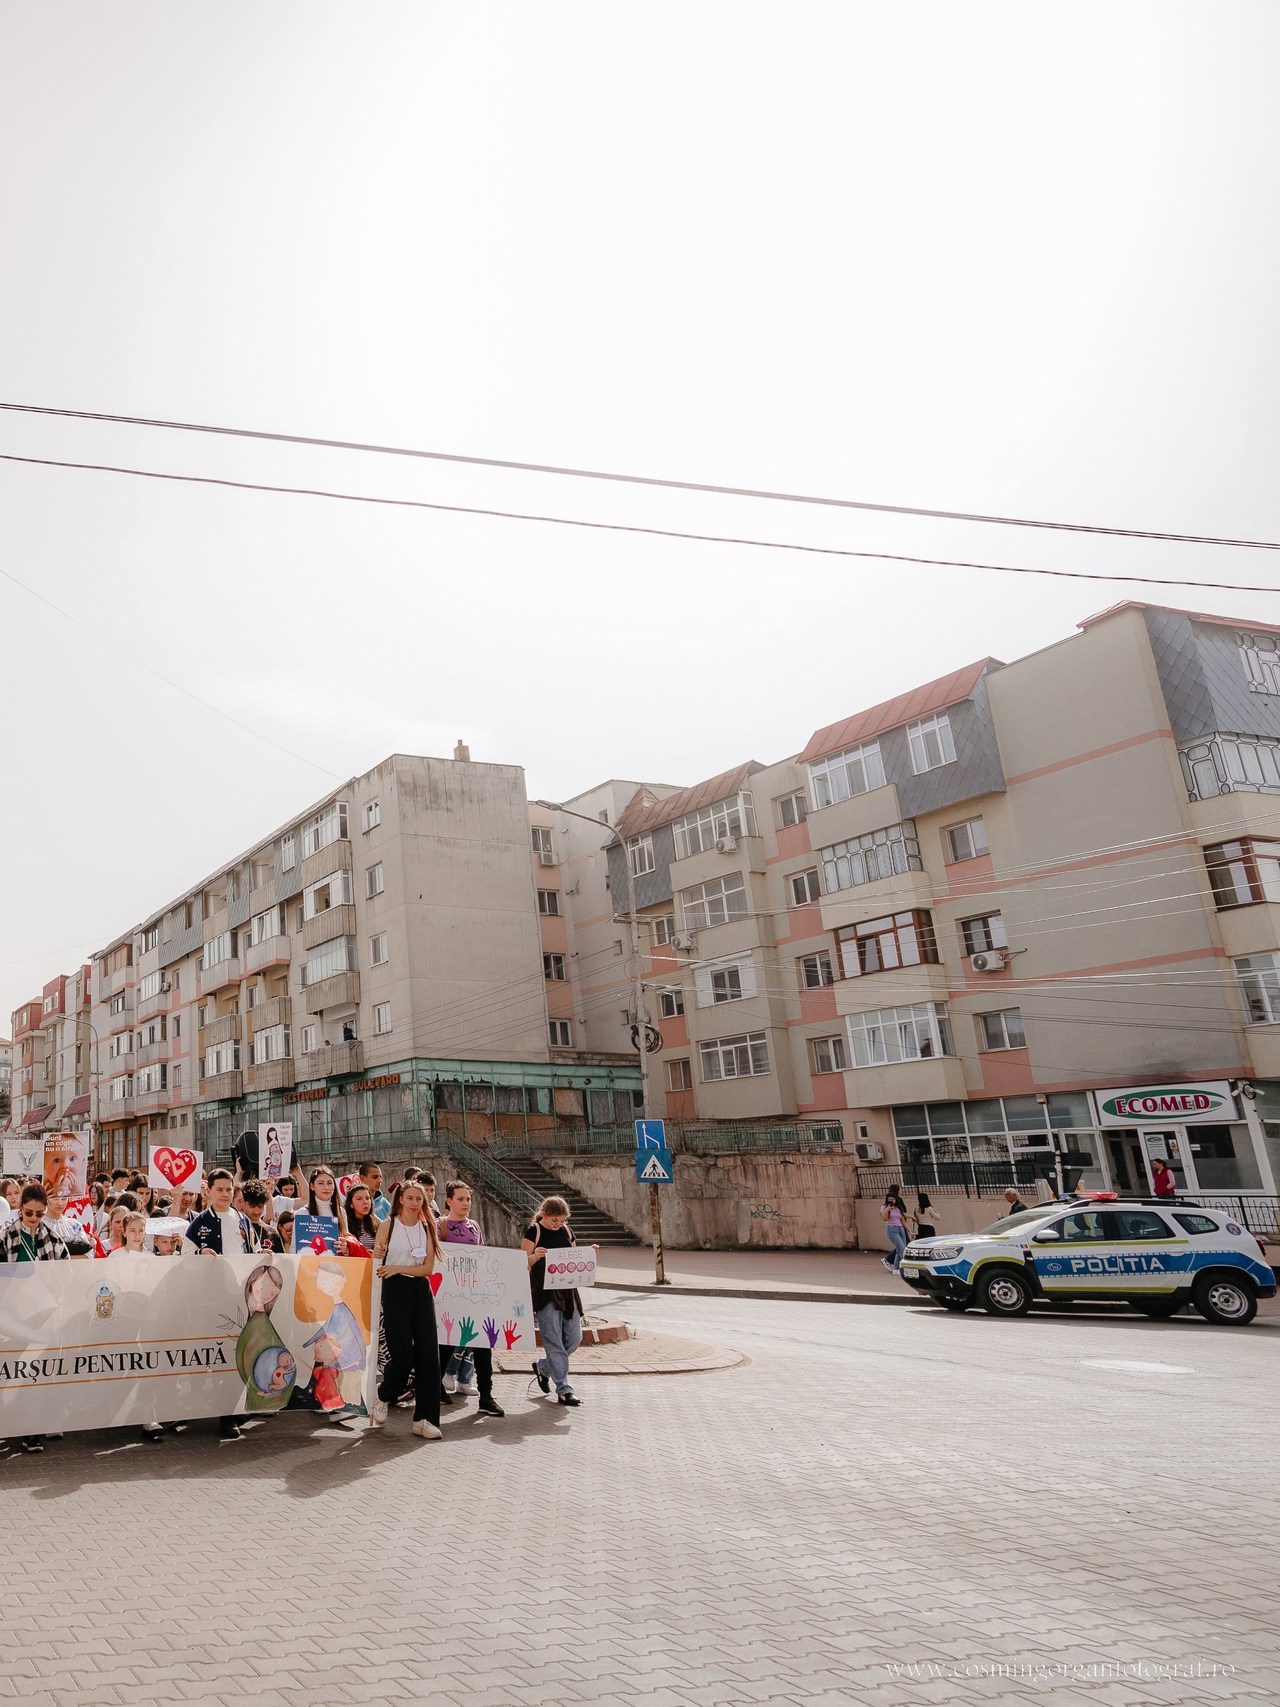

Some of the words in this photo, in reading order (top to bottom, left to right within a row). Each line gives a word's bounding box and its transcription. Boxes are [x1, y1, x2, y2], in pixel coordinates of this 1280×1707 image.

[1115, 1094, 1211, 1115] ECOMED
[557, 1250, 584, 1260] ALEGE
[73, 1351, 160, 1375] PENTRU
[164, 1341, 228, 1371] VIAȚĂ
